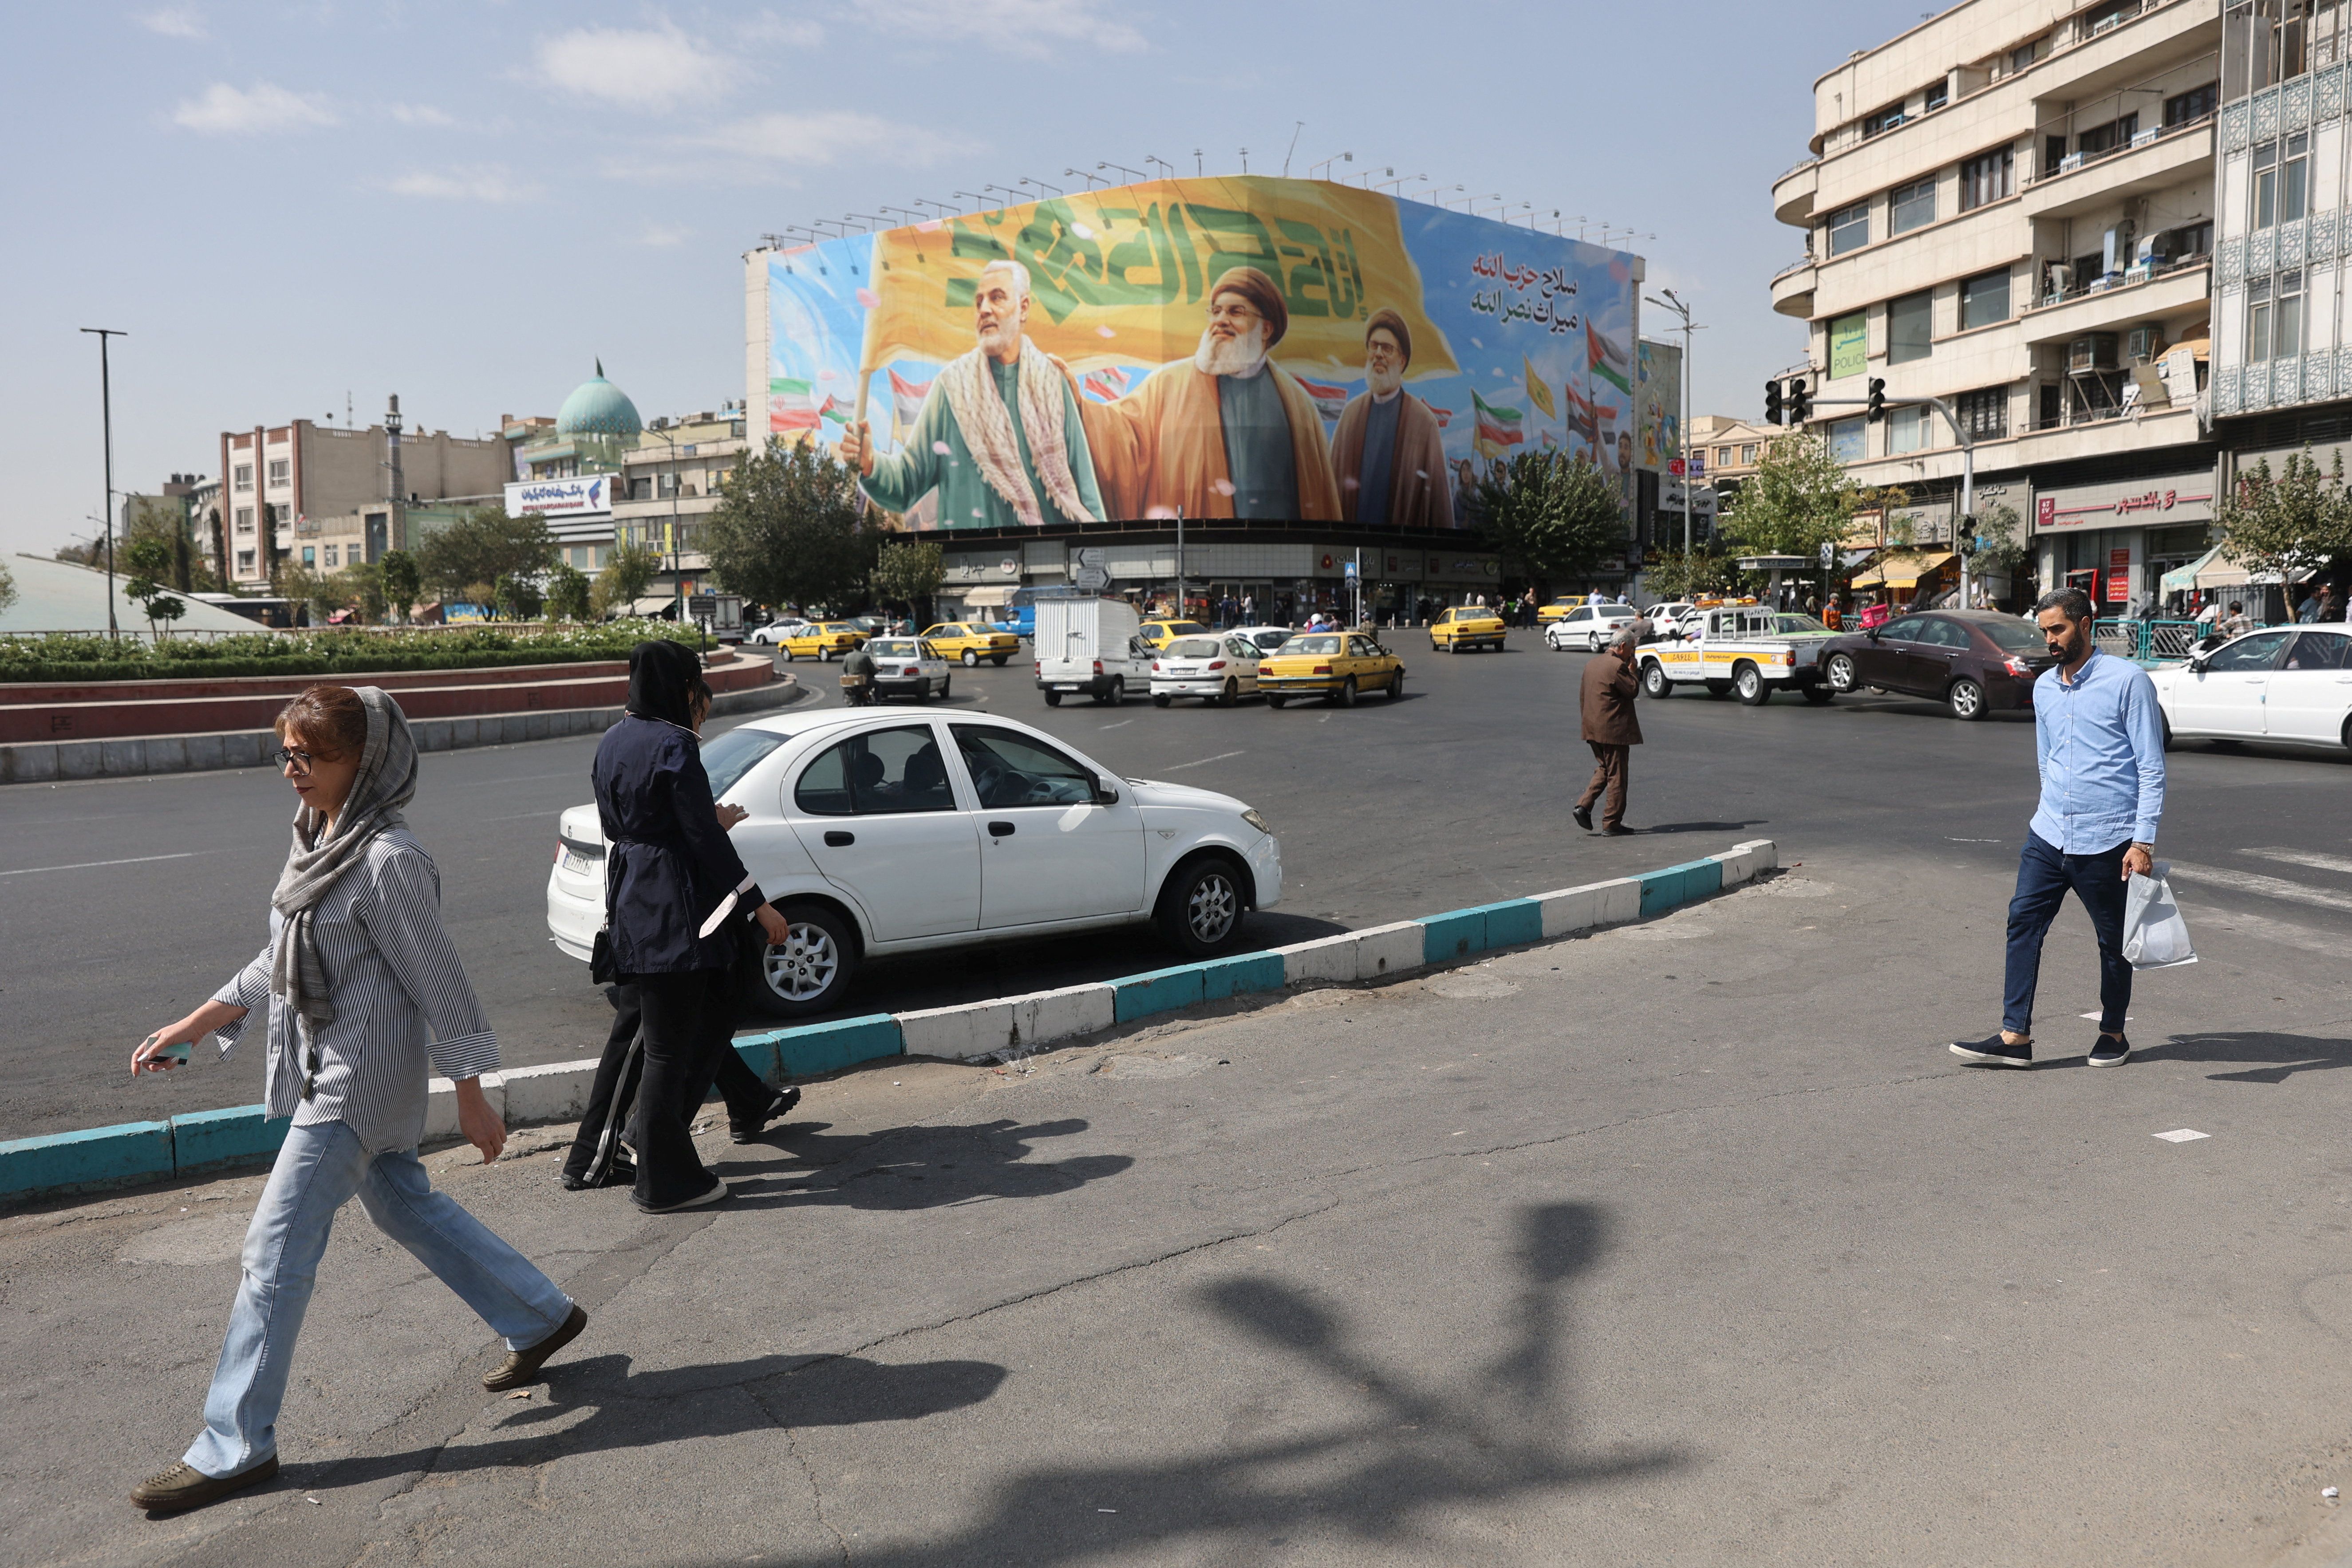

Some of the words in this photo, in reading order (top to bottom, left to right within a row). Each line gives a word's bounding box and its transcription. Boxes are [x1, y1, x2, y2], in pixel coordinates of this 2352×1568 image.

[1504, 264, 1539, 292] حزب
[1542, 266, 1577, 298] سلاح
[1500, 298, 1531, 324] نصر
[1533, 300, 1578, 333] میراث
[1834, 351, 1867, 370] POLICE
[522, 486, 545, 501] کارگران
[546, 485, 565, 499] رفاه
[565, 484, 584, 498] بانک
[1978, 484, 2006, 498] ساختمان
[2140, 491, 2161, 510] بانک
[2115, 496, 2140, 513] شهر
